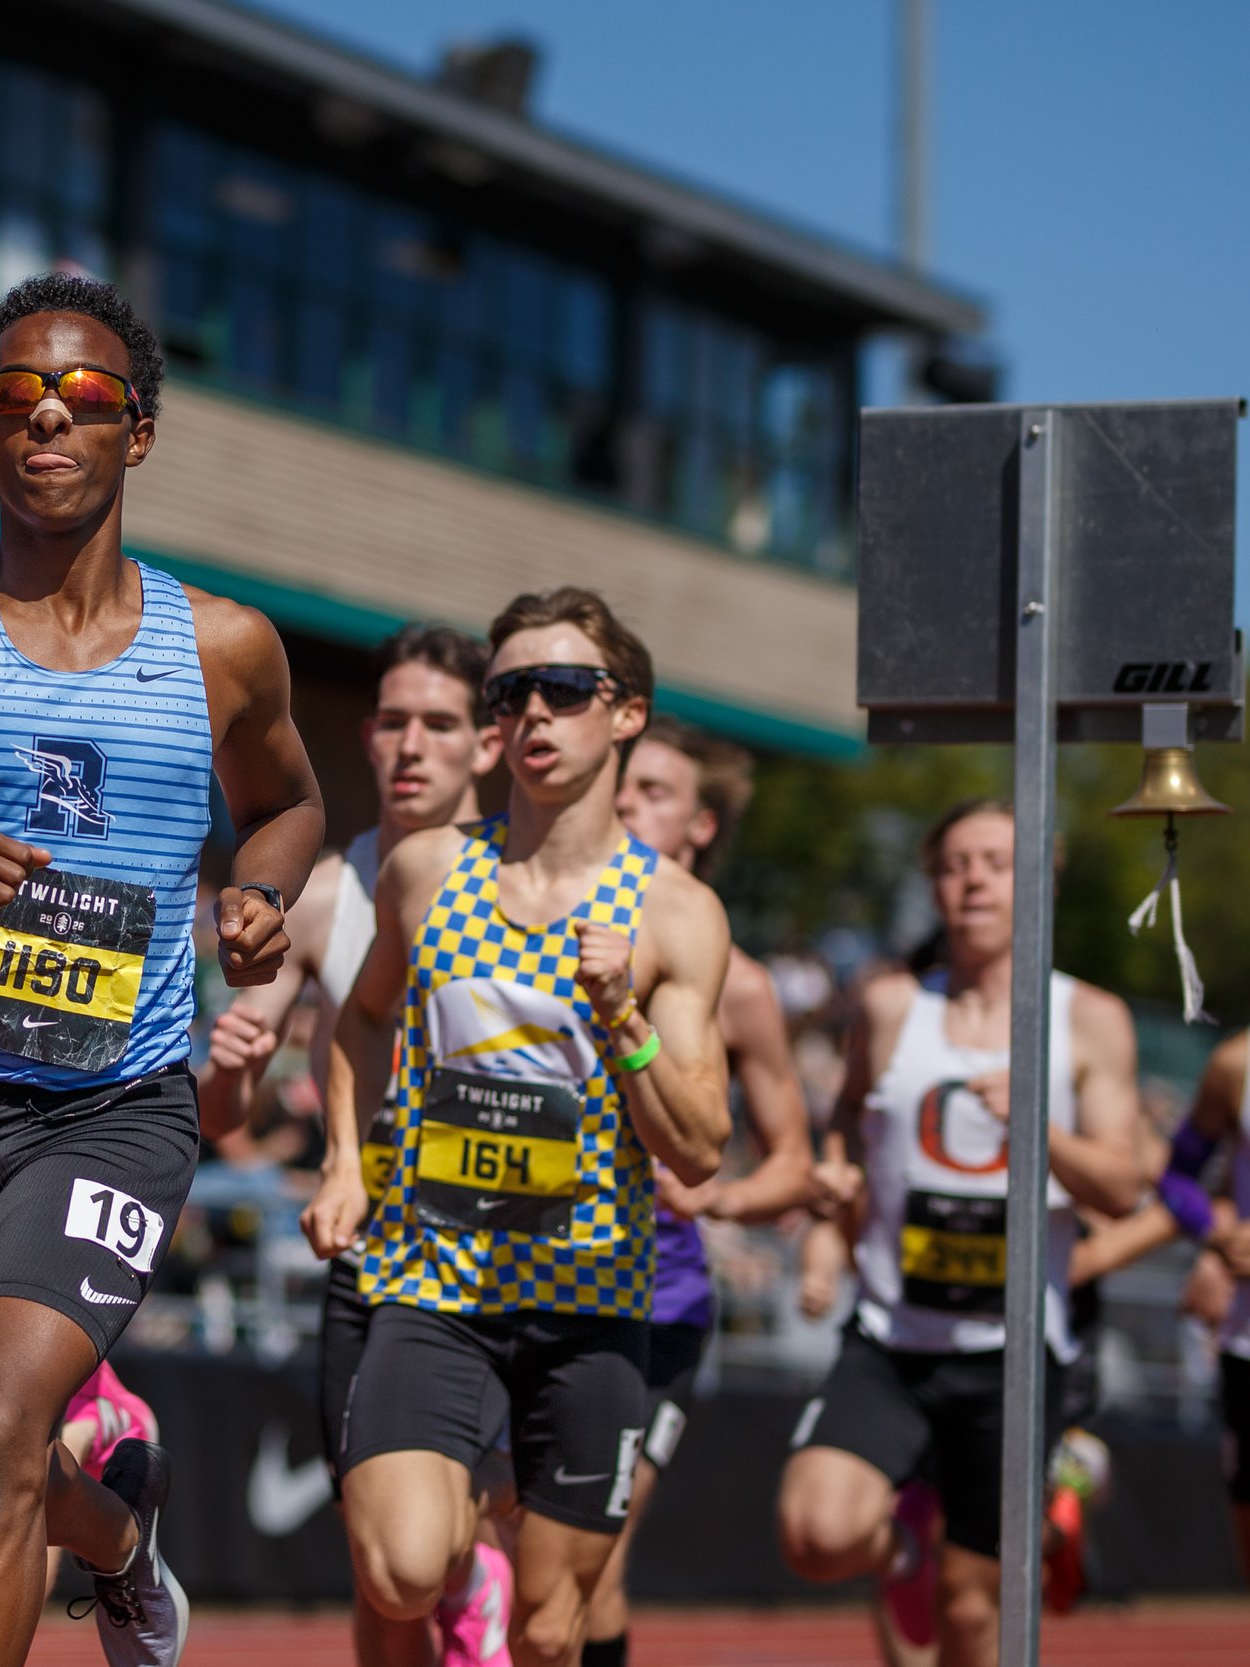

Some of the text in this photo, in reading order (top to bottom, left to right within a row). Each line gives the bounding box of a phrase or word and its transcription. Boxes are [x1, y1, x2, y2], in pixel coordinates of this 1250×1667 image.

[1113, 661, 1211, 692] GILL
[18, 880, 119, 915] TWILIGHT
[456, 1084, 544, 1112] TWILIGHT
[461, 1138, 530, 1184] 164
[90, 1190, 146, 1258] 19
